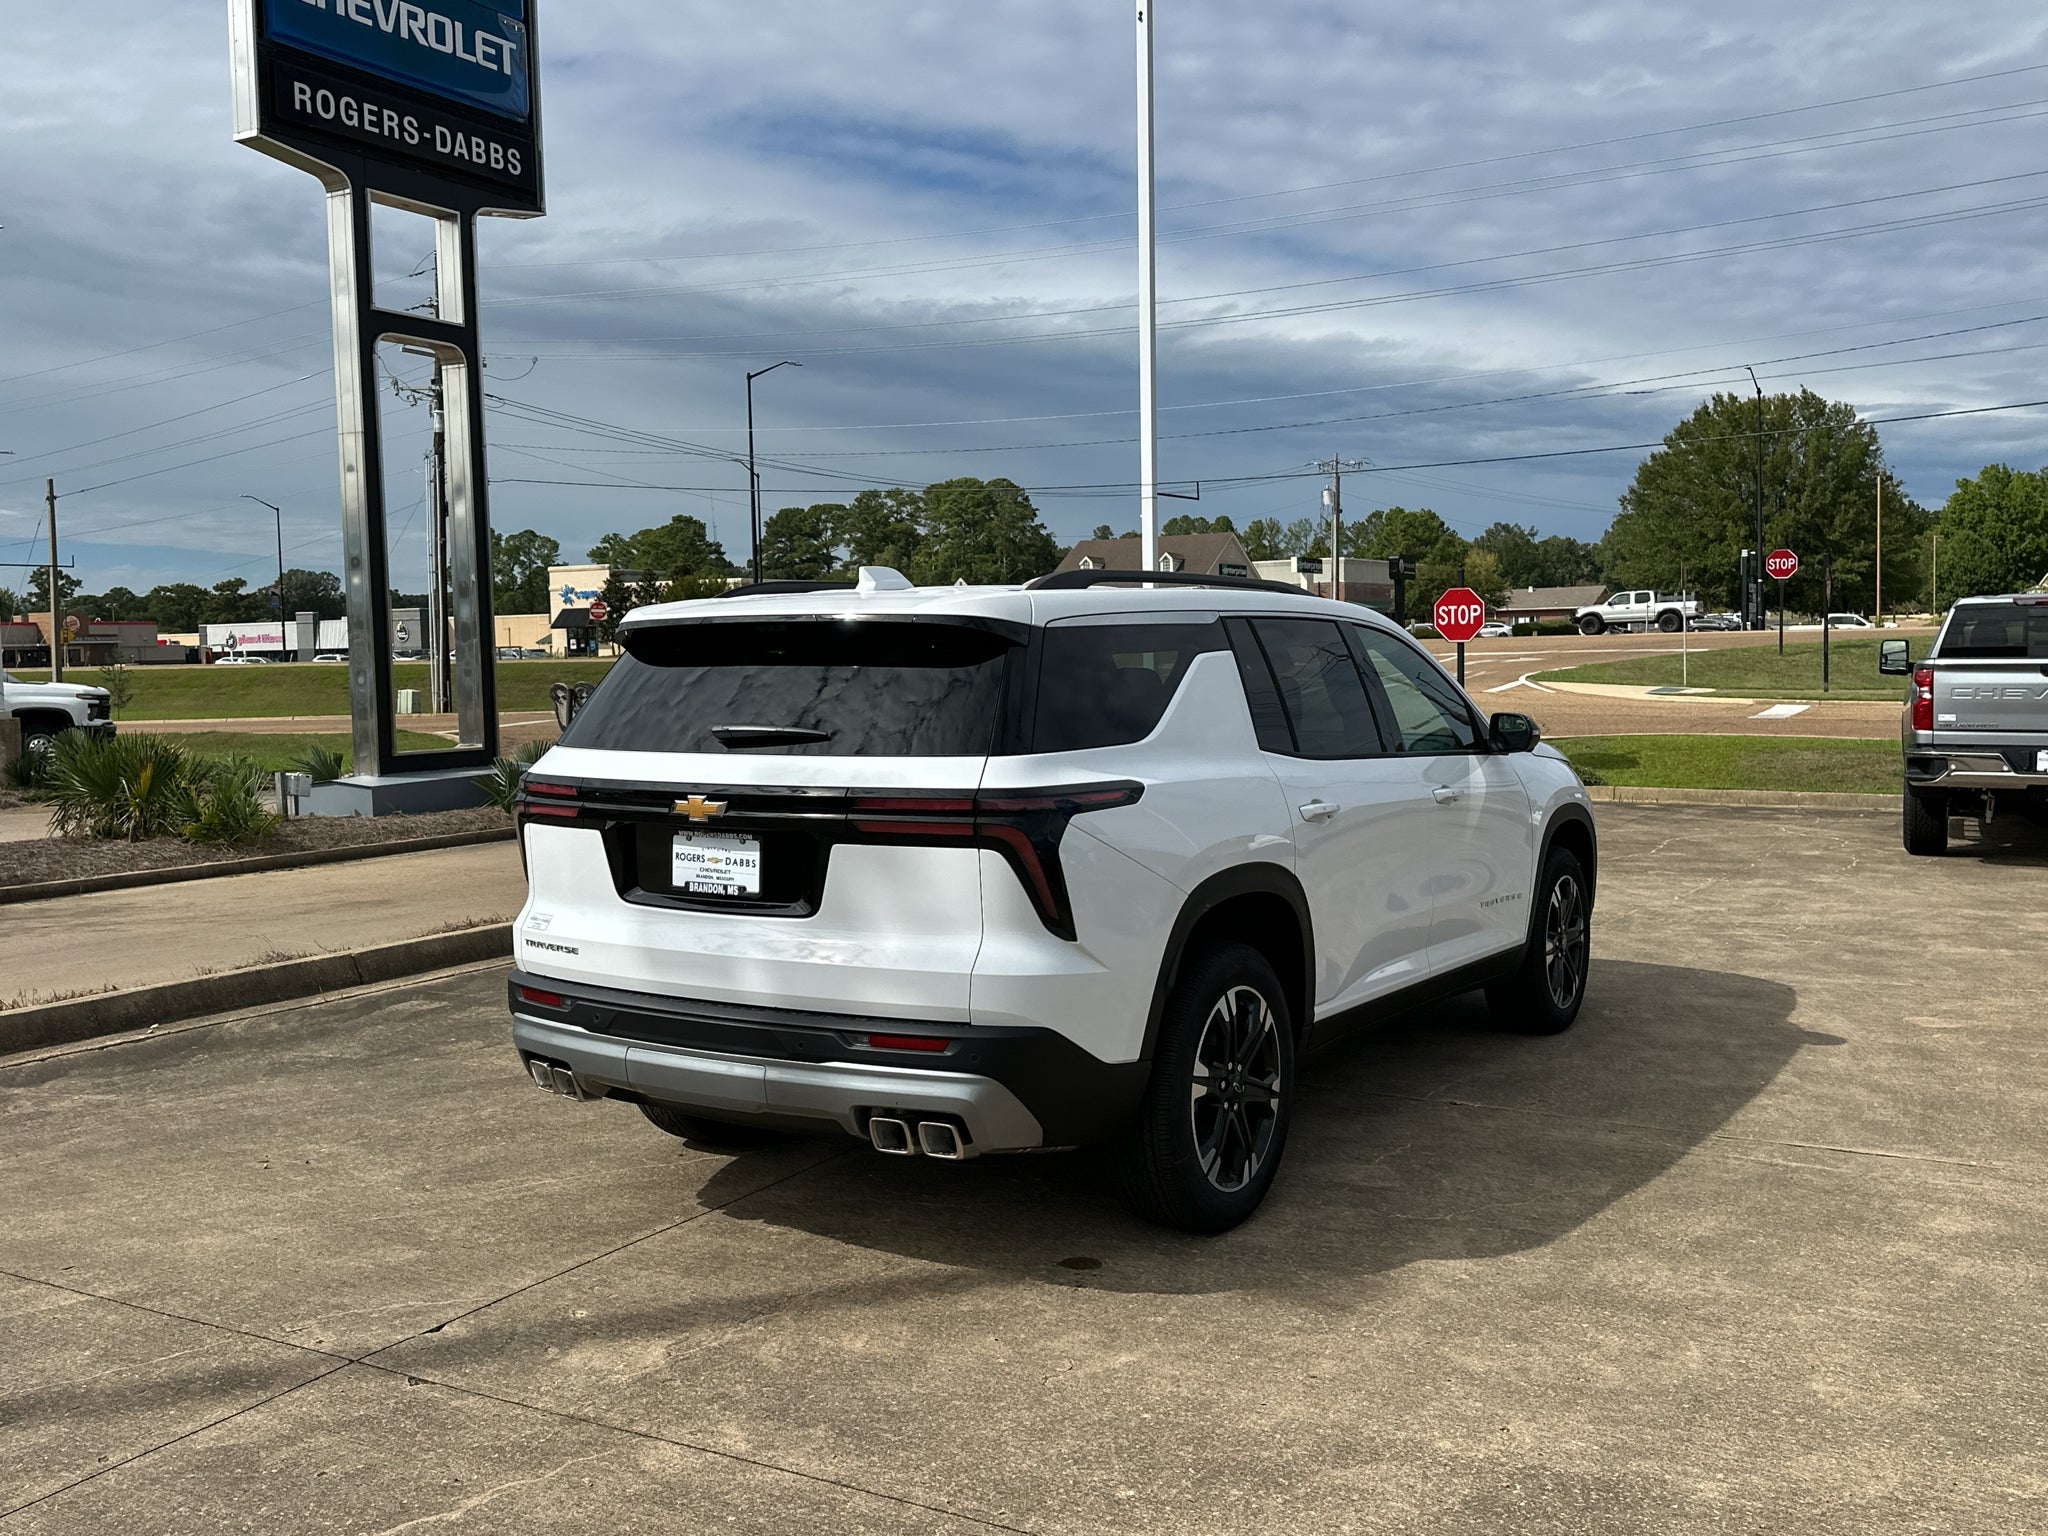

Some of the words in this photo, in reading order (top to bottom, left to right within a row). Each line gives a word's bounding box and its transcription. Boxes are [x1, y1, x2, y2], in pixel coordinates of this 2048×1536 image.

[302, 0, 517, 75] EVROLET
[293, 81, 522, 176] ROGERS-DABBS
[1768, 558, 1796, 570] STOP
[1437, 604, 1481, 625] STOP
[675, 852, 706, 863] ROGERS
[725, 857, 757, 868] DABBS
[689, 882, 726, 895] BRANDON,
[727, 885, 739, 895] MS
[524, 938, 579, 955] TRAVERSE
